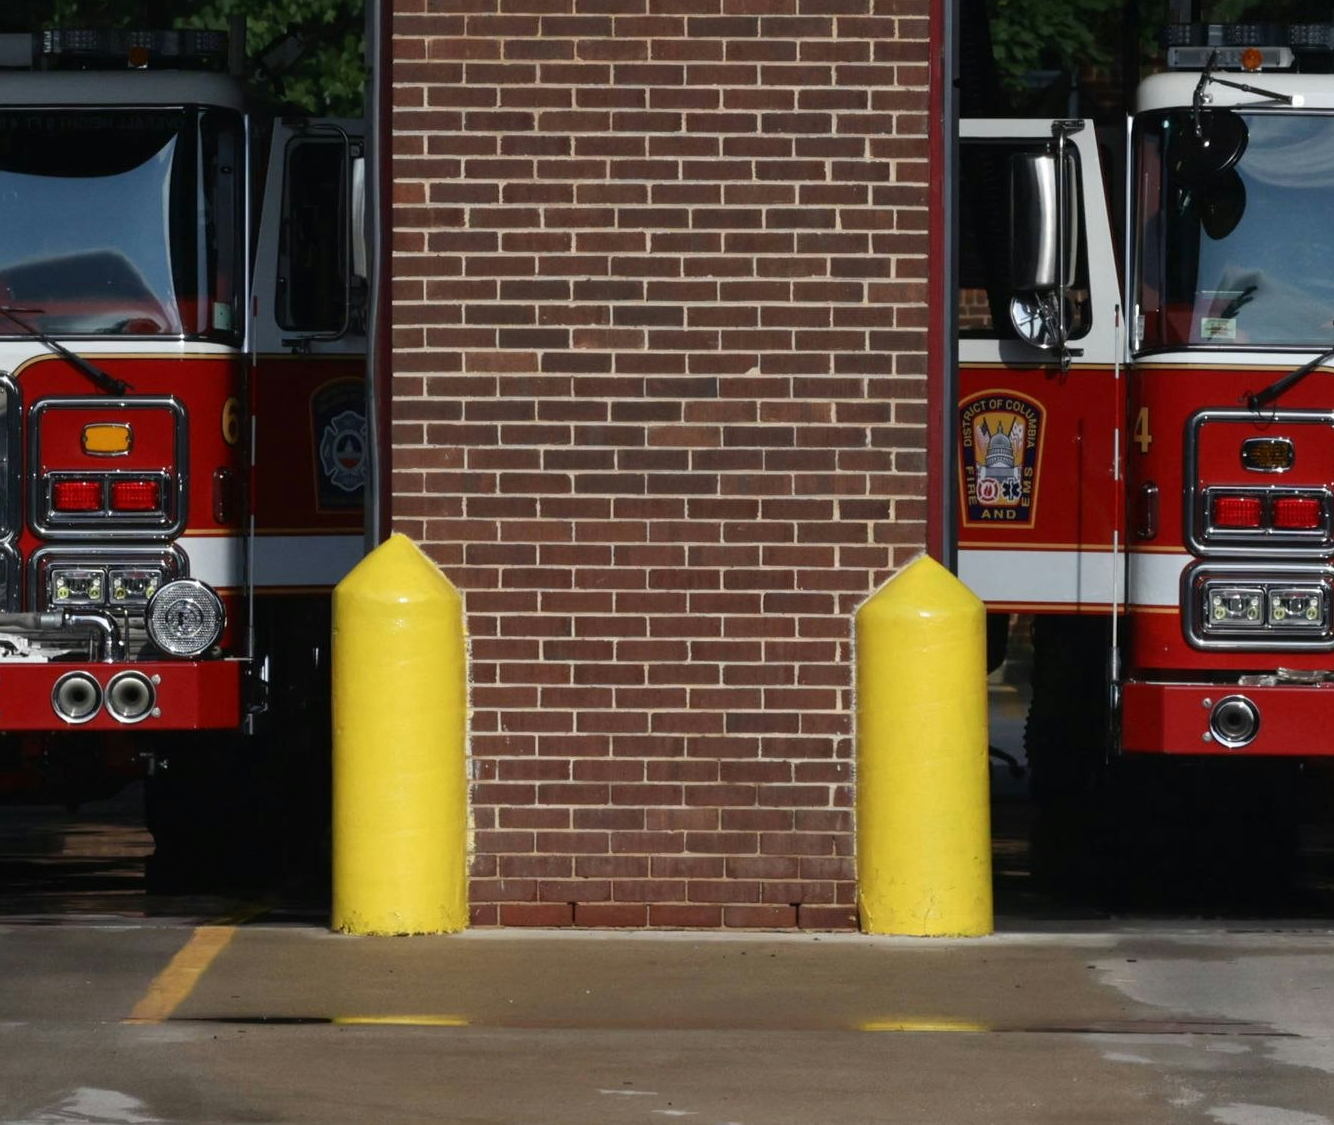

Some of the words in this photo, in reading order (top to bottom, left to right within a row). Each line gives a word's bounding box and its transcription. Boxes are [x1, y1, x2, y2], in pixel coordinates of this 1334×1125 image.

[222, 396, 241, 446] 6
[963, 400, 987, 447] DISTRICT
[989, 399, 1004, 410] OF
[1005, 399, 1038, 449] COLUMBIA
[1133, 406, 1152, 453] 4
[965, 465, 978, 505] FIRE
[981, 508, 1017, 519] AND
